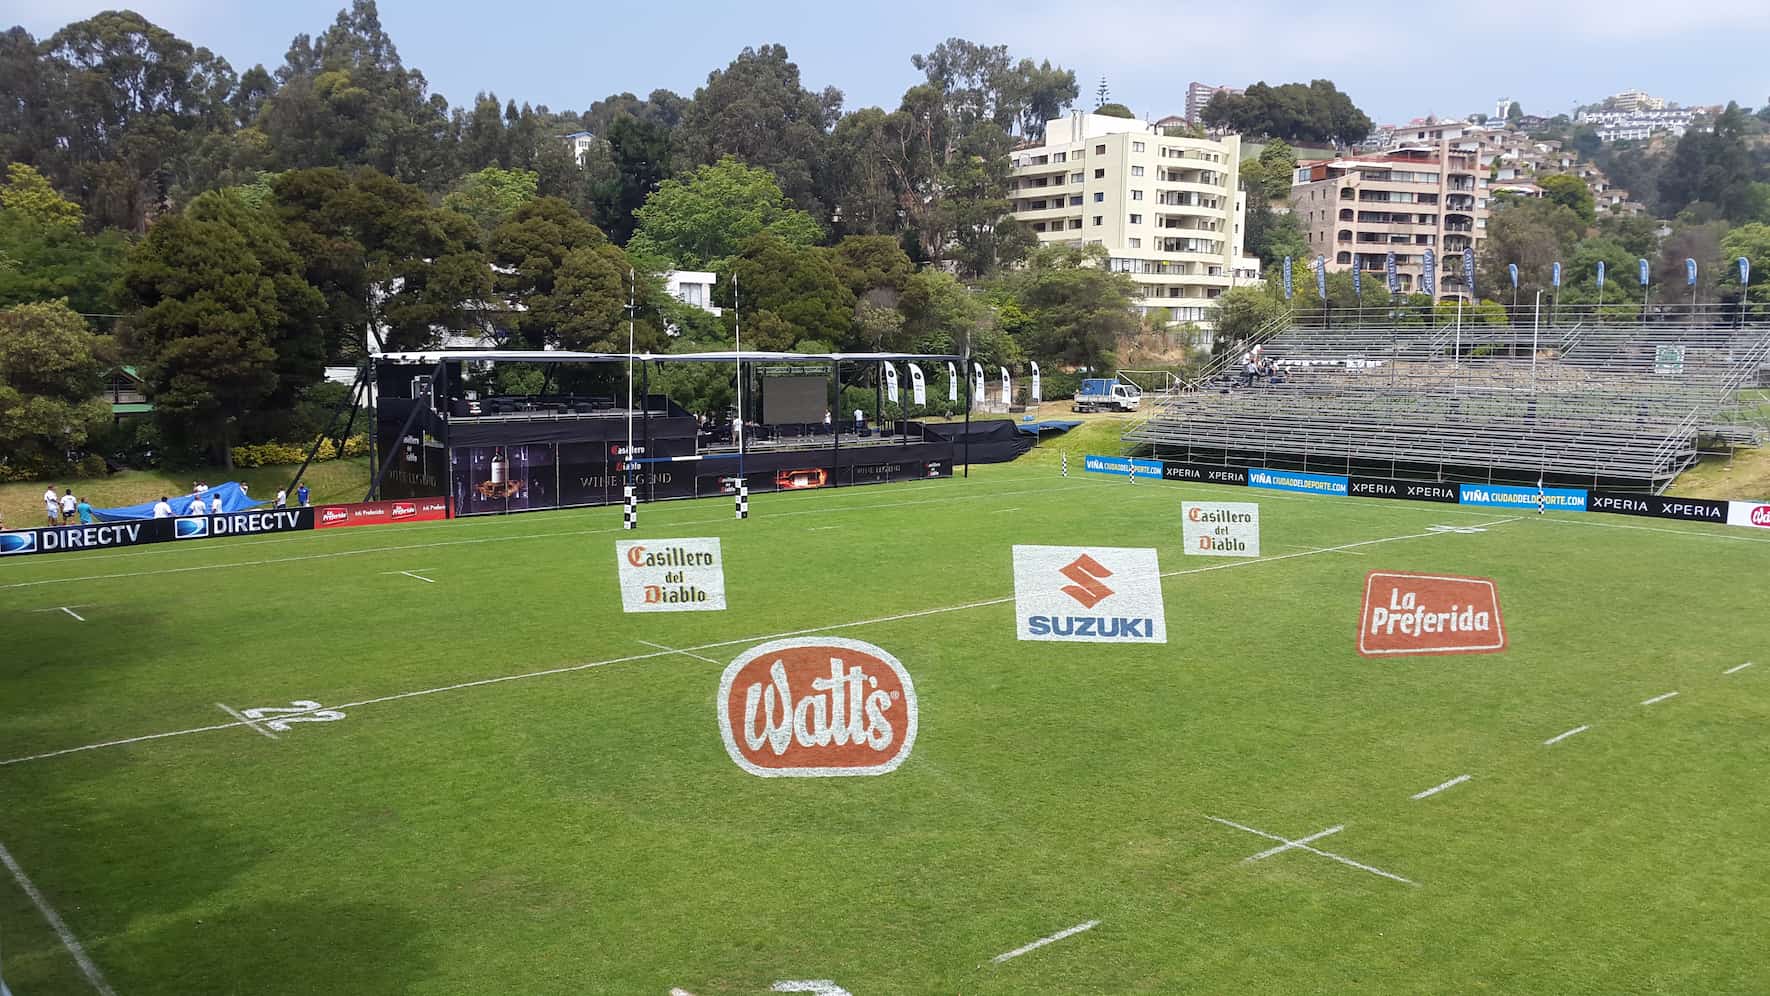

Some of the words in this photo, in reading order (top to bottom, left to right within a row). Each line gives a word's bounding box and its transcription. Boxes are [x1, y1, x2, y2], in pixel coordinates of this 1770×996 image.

[1086, 460, 1104, 470] VIÑA
[1166, 467, 1200, 478] XPERIA
[1208, 471, 1245, 482] XPERIA
[1250, 473, 1272, 485] VIÑA
[1352, 483, 1397, 495] XPERIA
[1407, 486, 1454, 498] XPERIA
[1462, 490, 1490, 502] VIÑA
[1593, 497, 1648, 511] XPERIA
[1662, 503, 1721, 517] XPERIA
[1189, 507, 1251, 523] Casillero
[213, 510, 300, 535] DIRECTV
[42, 524, 141, 550] DIRECTV
[1215, 526, 1229, 535] del
[1200, 536, 1245, 551] Diablo
[627, 546, 712, 567] Casillero
[665, 571, 683, 583] del
[643, 585, 706, 603] Diablo
[1390, 588, 1416, 610] La
[1028, 616, 1153, 638] SUZUKI
[1371, 605, 1489, 637] Preferida
[744, 658, 892, 755] Watt's
